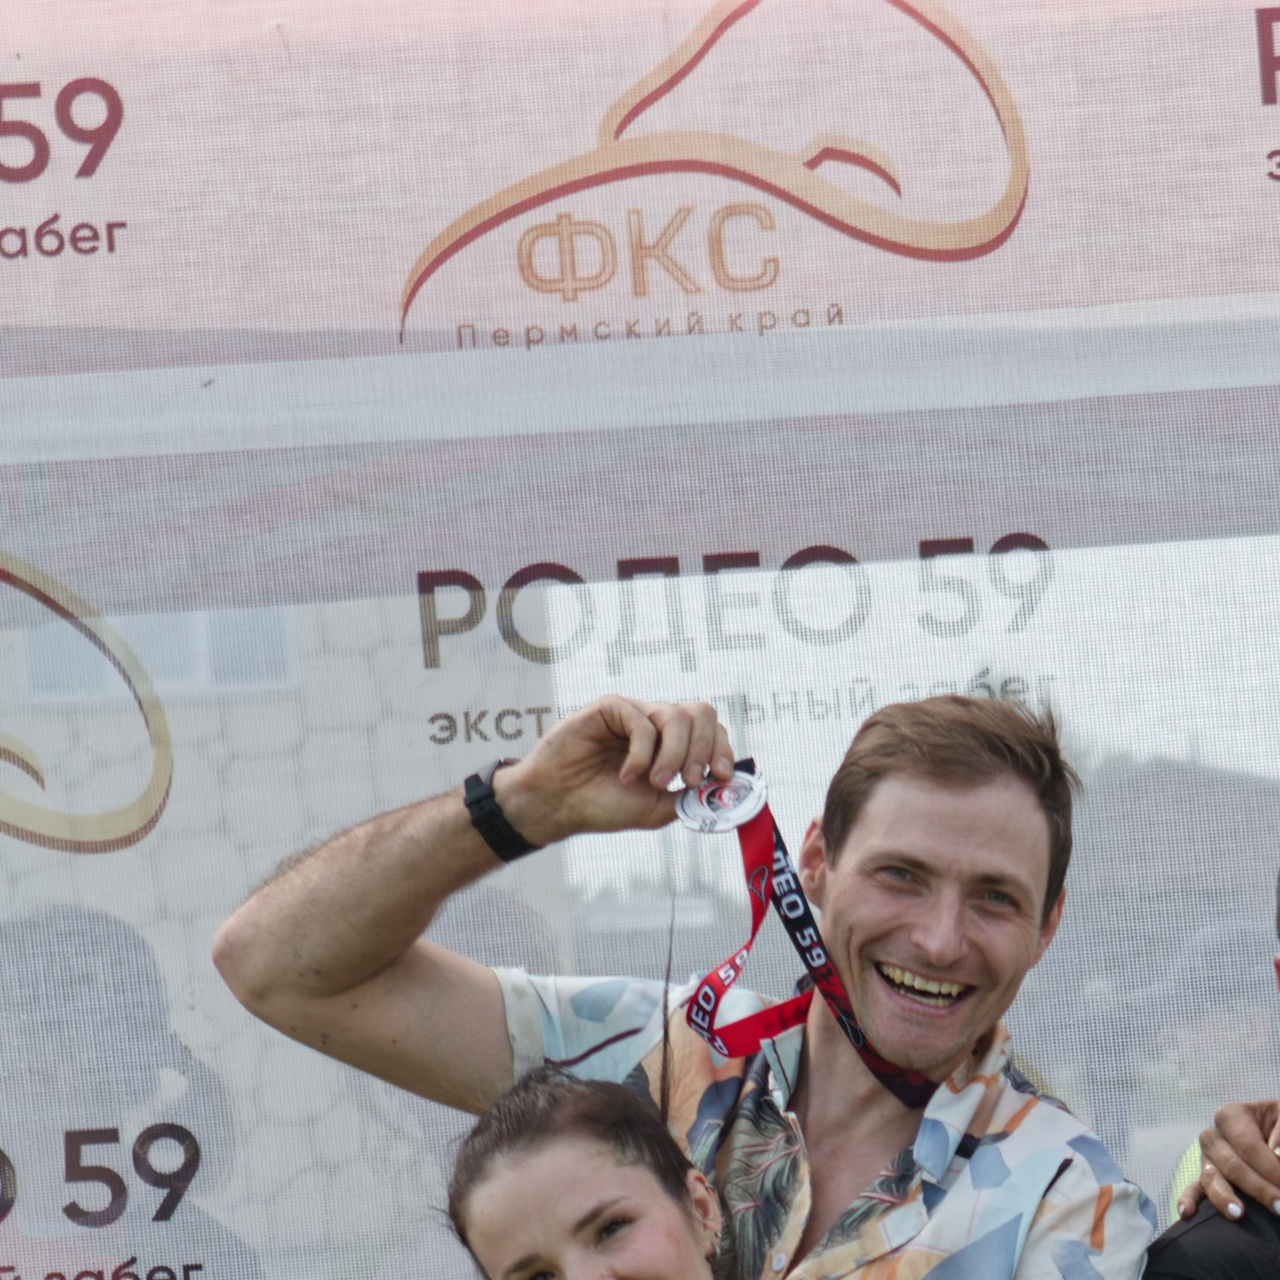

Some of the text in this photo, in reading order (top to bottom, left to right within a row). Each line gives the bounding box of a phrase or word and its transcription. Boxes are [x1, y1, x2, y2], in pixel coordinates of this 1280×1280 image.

[516, 202, 781, 302] ФКС
[456, 302, 845, 351] Пермский край
[416, 532, 1055, 675] РОДЕО 59
[796, 926, 826, 968] 59
[62, 1122, 201, 1229] 59
